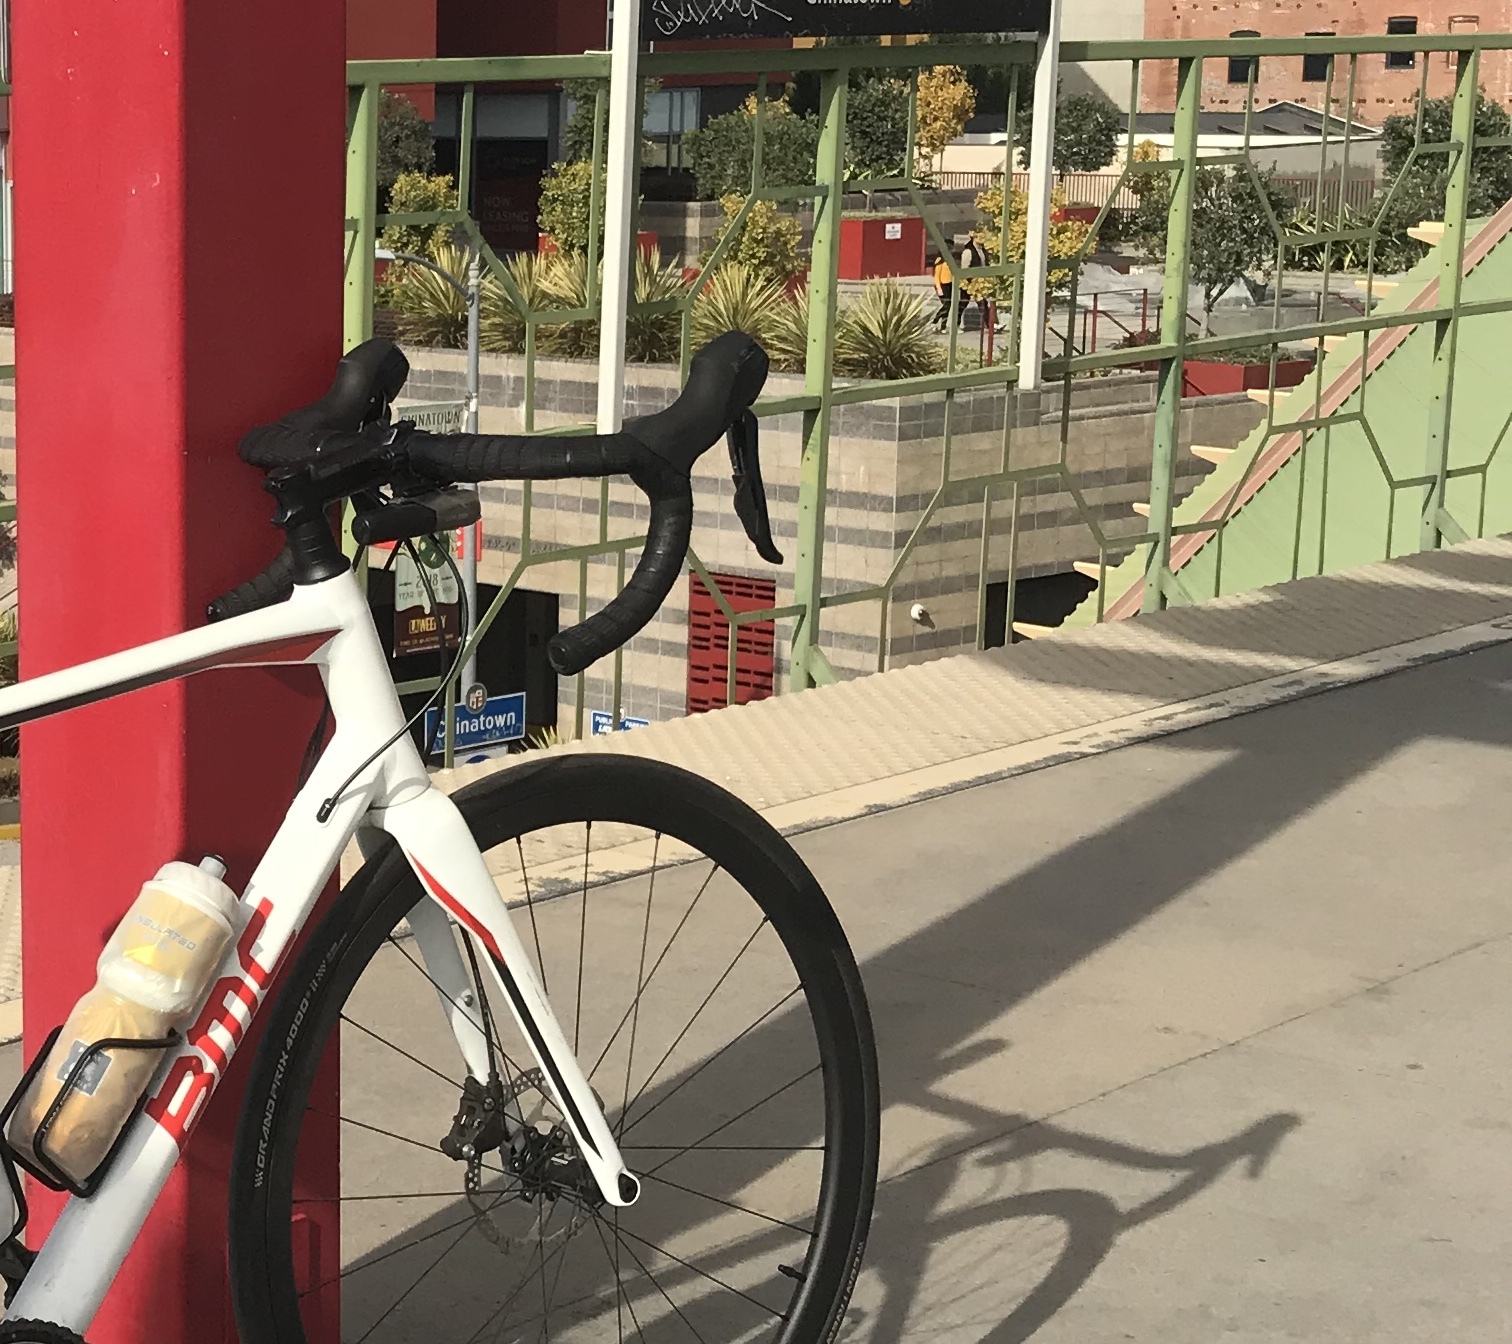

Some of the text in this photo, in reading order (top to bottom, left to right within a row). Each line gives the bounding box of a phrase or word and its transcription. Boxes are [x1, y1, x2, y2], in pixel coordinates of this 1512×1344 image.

[436, 711, 516, 738] Cinatown
[256, 1098, 276, 1170] GRAND
[271, 1051, 290, 1097] PRIX
